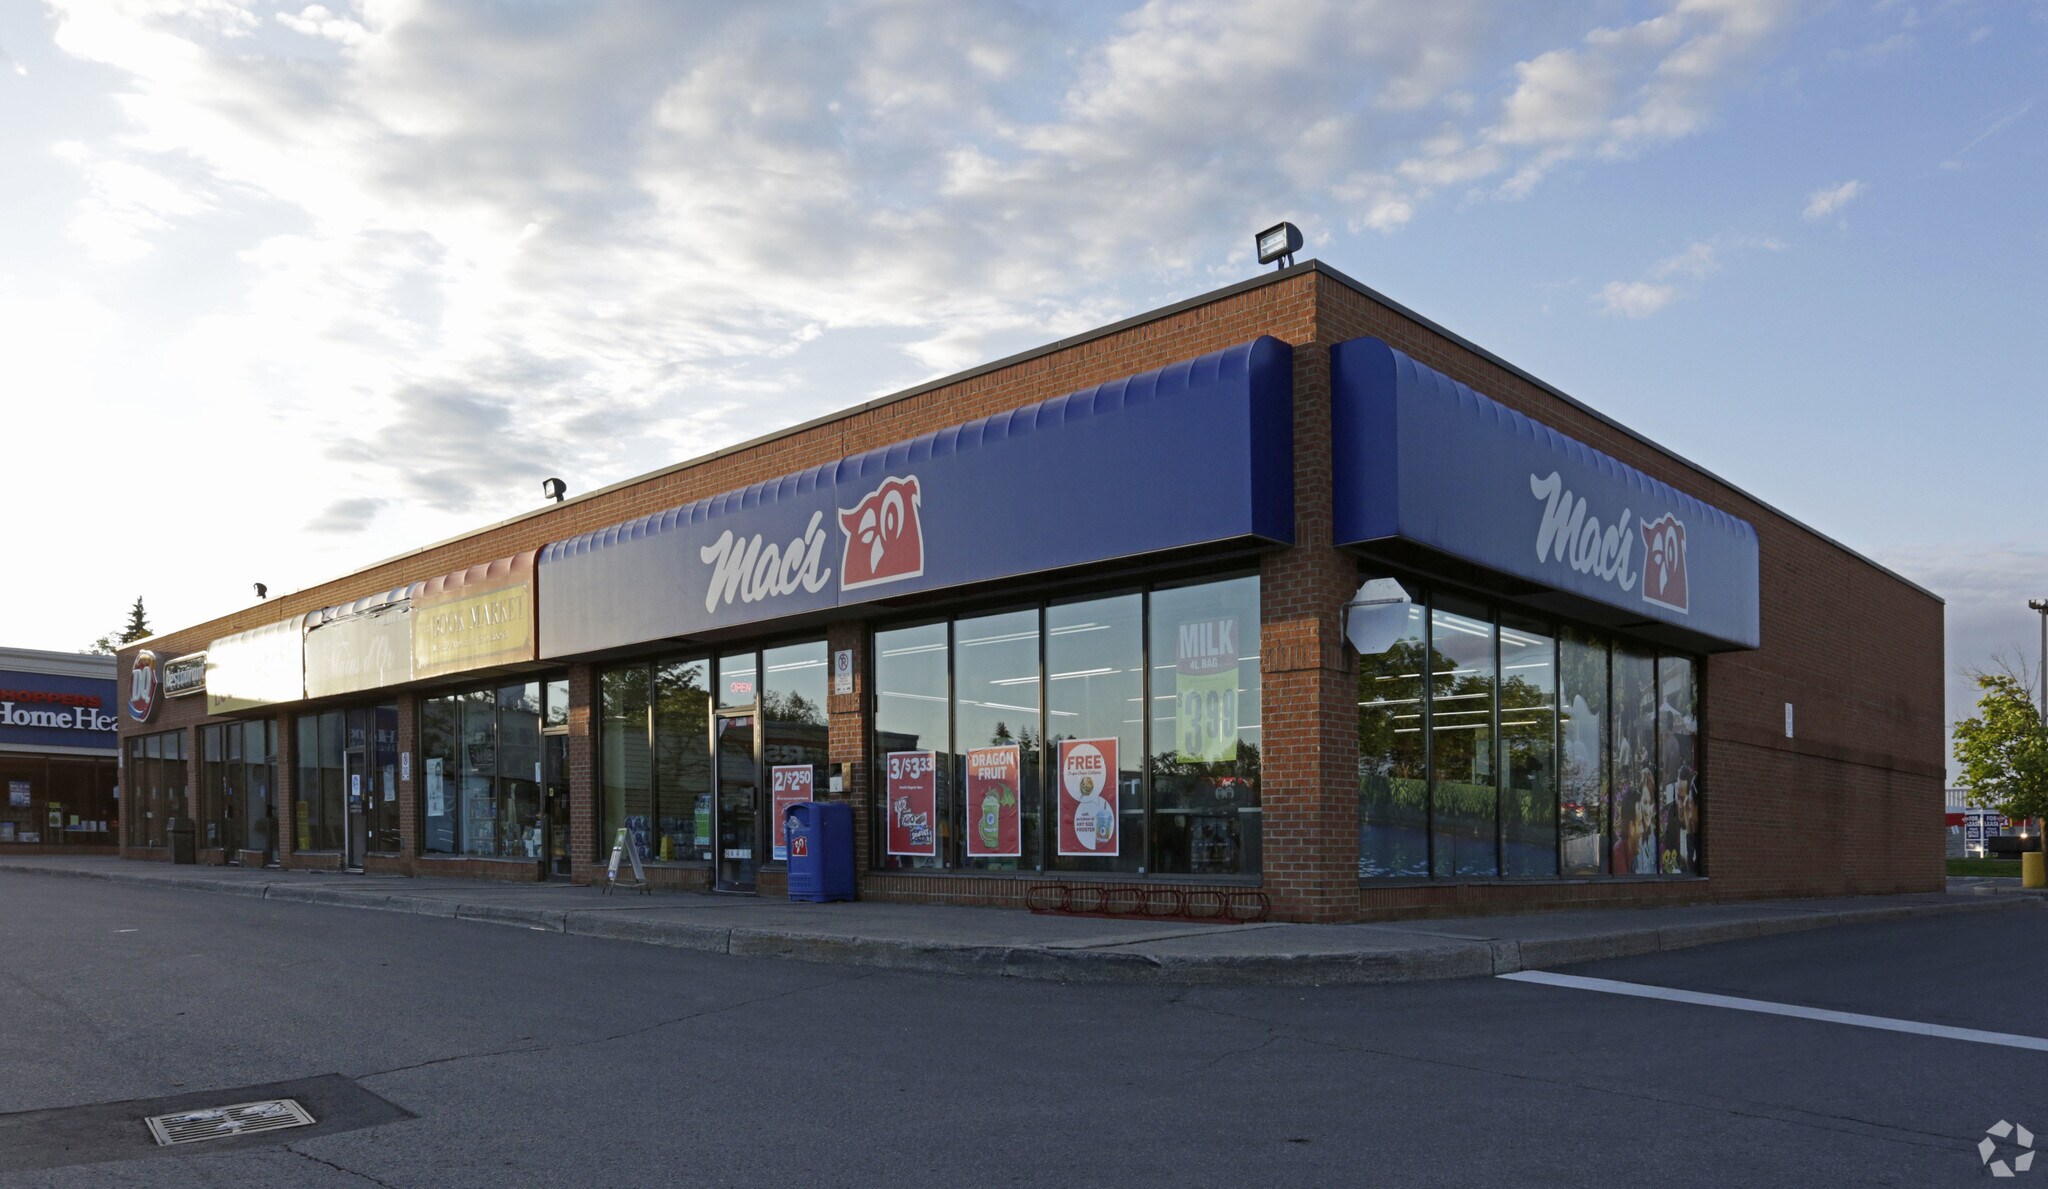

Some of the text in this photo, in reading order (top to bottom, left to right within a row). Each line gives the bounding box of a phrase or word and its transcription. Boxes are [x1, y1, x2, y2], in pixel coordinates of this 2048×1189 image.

[1530, 471, 1637, 591] Mac's
[700, 510, 831, 614] Mac's
[432, 609, 464, 639] BOOK
[469, 595, 523, 629] MARKET
[1179, 619, 1234, 659] MILK
[1190, 657, 1218, 670] 4L BAG
[131, 665, 152, 704] DQ
[730, 682, 753, 693] OPEN
[0, 689, 102, 708] HOPPERS
[971, 752, 1014, 767] DRAGON
[1067, 755, 1102, 770] FREE
[978, 766, 1007, 780] FRUIT
